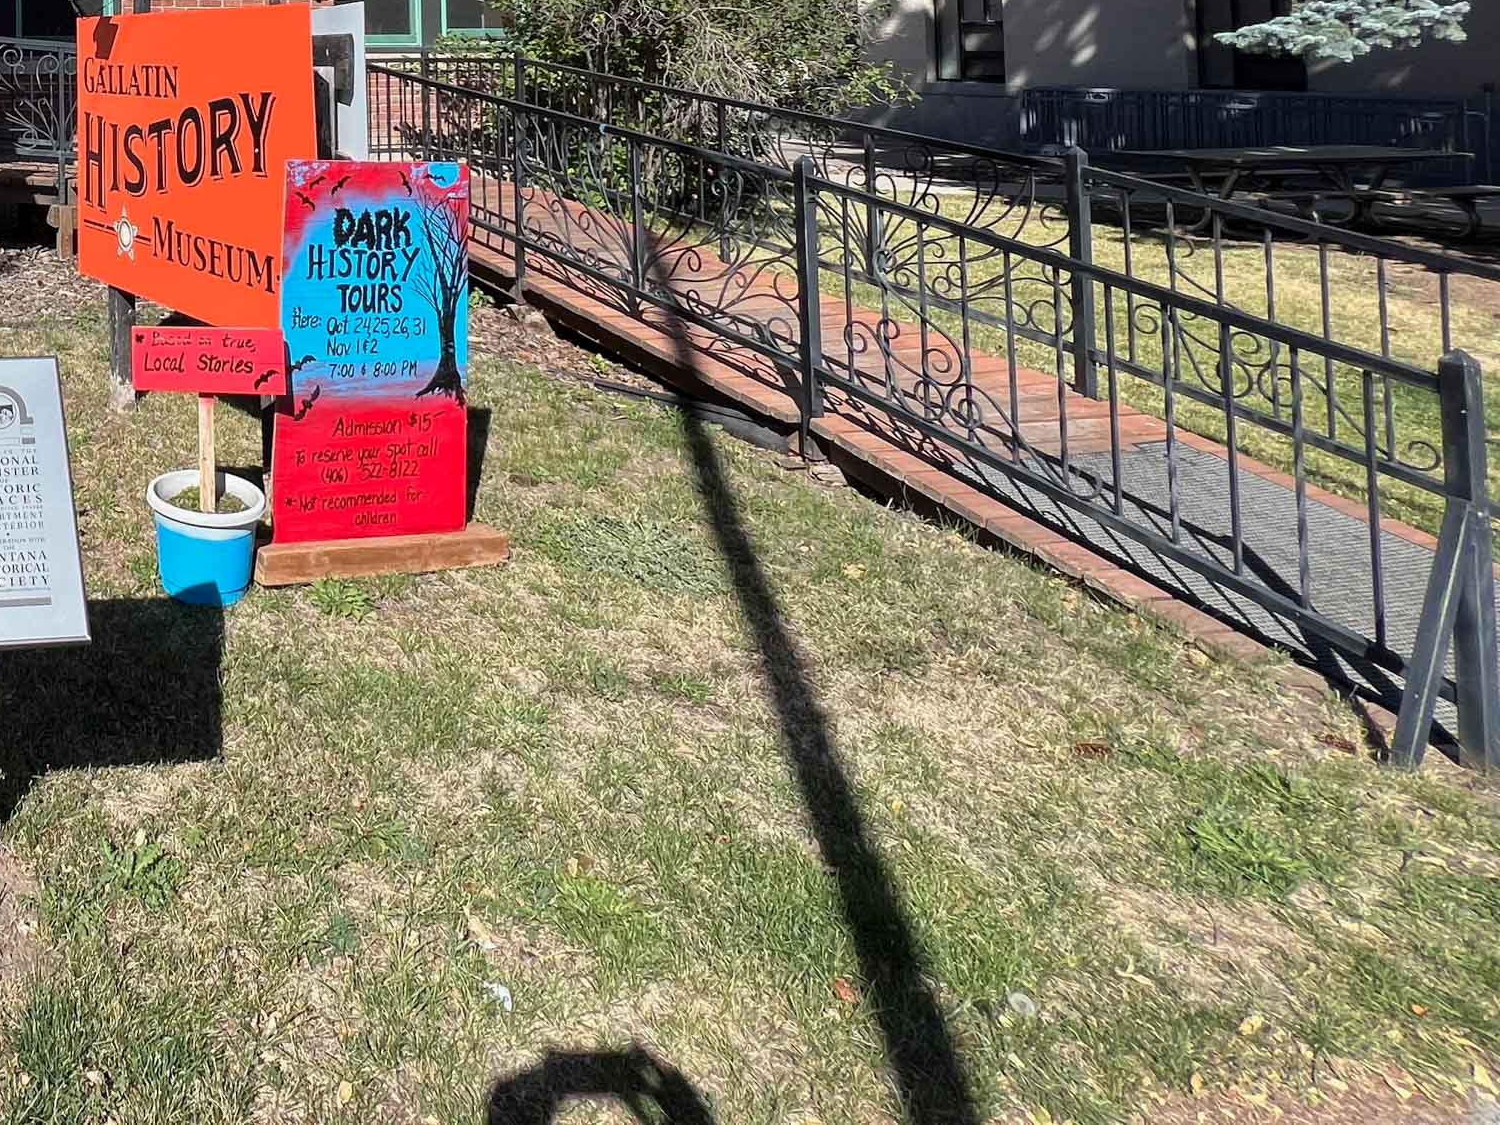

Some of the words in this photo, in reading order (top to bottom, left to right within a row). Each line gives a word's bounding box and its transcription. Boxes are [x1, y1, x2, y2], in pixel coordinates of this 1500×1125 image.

[83, 57, 179, 100] GALLATIN
[84, 91, 276, 214] HISTORY
[333, 207, 412, 251] DARK
[151, 216, 276, 295] MUSEUM
[306, 244, 421, 282] HISTORY
[336, 284, 403, 314] TOURS
[326, 315, 349, 335] Oct
[221, 333, 257, 353] true,
[326, 337, 351, 356] Nov
[144, 352, 185, 373] Local
[197, 353, 254, 374] Stories
[329, 363, 354, 378] 7:00
[373, 362, 397, 377] 8:00
[401, 360, 418, 378] PM
[332, 417, 402, 437] Admission
[295, 449, 306, 467] To
[312, 448, 353, 463] reserve
[357, 447, 380, 468] your
[416, 435, 438, 457] call
[320, 465, 349, 484] (406)
[300, 493, 318, 512] Not
[322, 490, 397, 510] recommended
[406, 486, 423, 502] for
